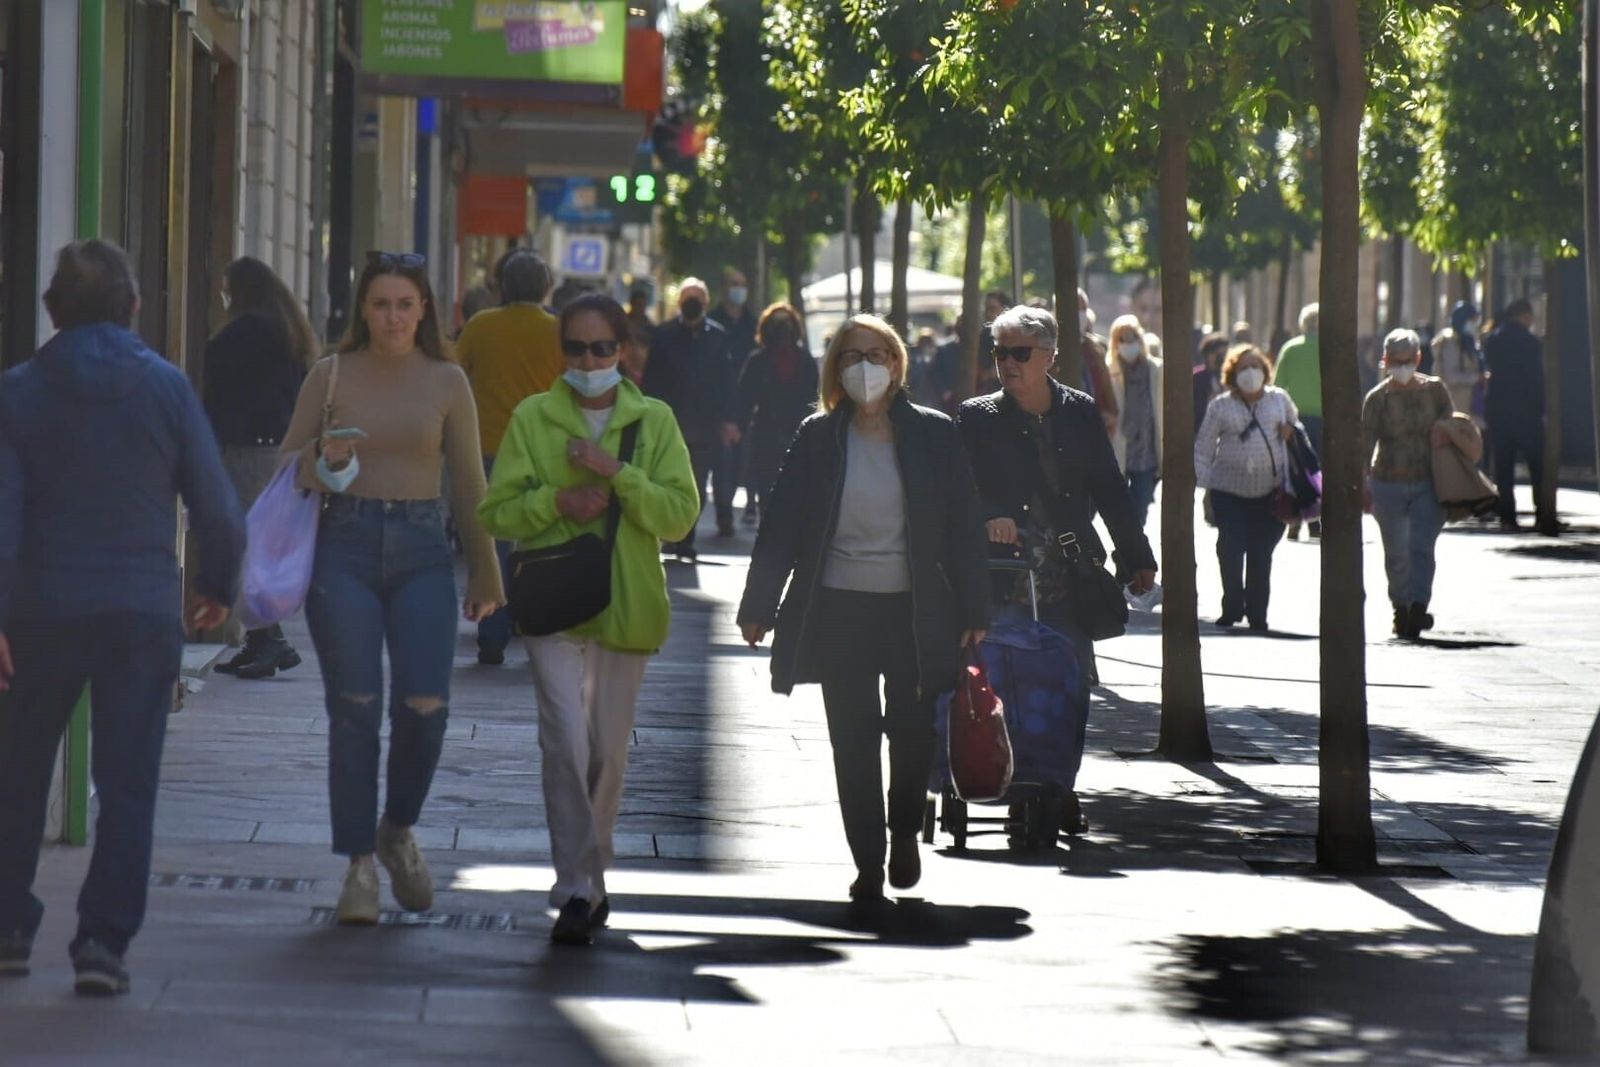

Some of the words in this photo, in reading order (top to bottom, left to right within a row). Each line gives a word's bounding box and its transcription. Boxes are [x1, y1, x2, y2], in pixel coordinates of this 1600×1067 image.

[383, 10, 438, 24] AROMAS
[379, 26, 453, 43] INCIENSOS
[382, 43, 443, 58] JABONES
